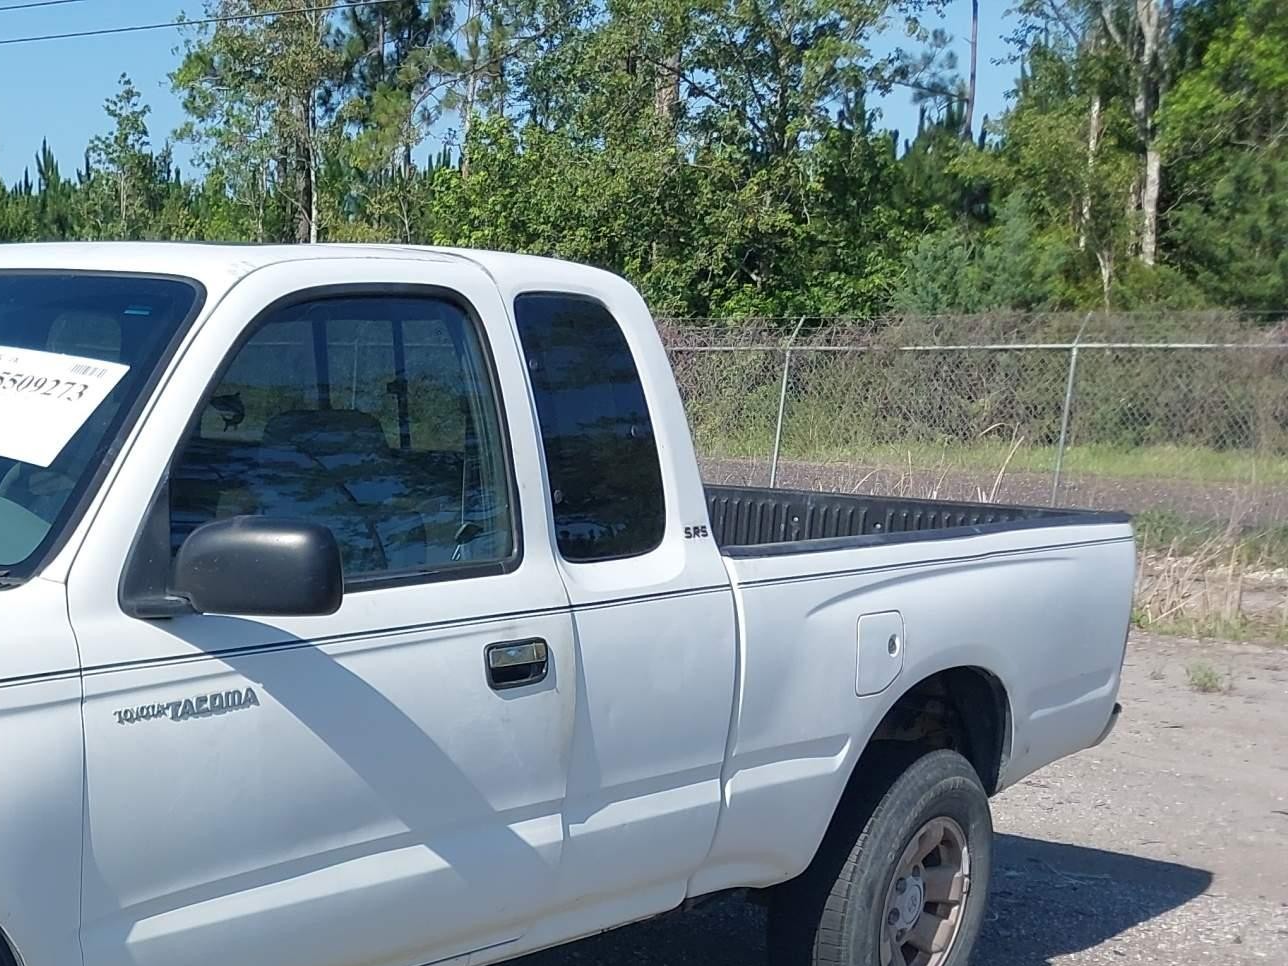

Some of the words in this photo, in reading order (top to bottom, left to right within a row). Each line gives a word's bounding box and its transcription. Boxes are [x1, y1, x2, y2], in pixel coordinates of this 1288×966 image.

[684, 525, 709, 539] SRS
[113, 702, 169, 725] TOYOTA
[166, 688, 261, 722] TACOMA
